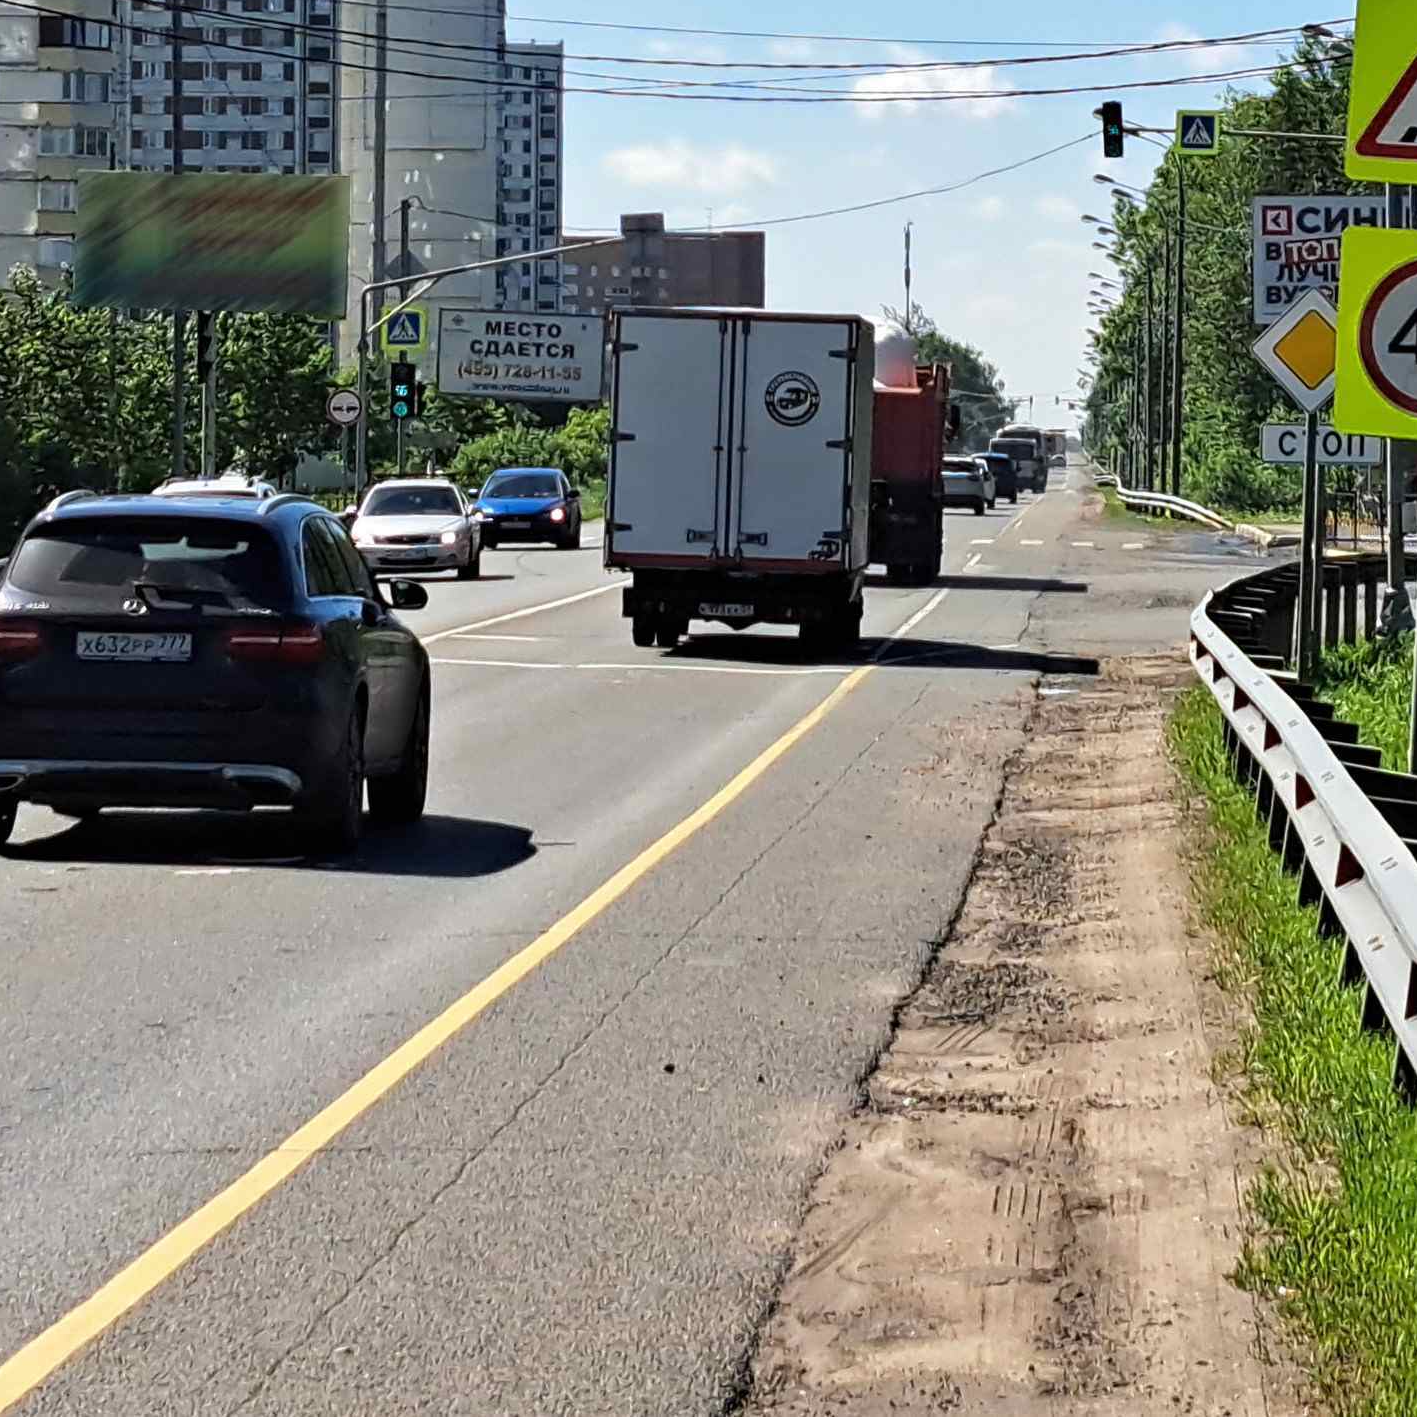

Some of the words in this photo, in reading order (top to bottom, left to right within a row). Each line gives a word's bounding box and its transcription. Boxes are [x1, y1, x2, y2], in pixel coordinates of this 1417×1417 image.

[1265, 242, 1282, 261] В
[485, 320, 562, 338] МЕСТО
[470, 339, 575, 359] СДАЕТСЯ
